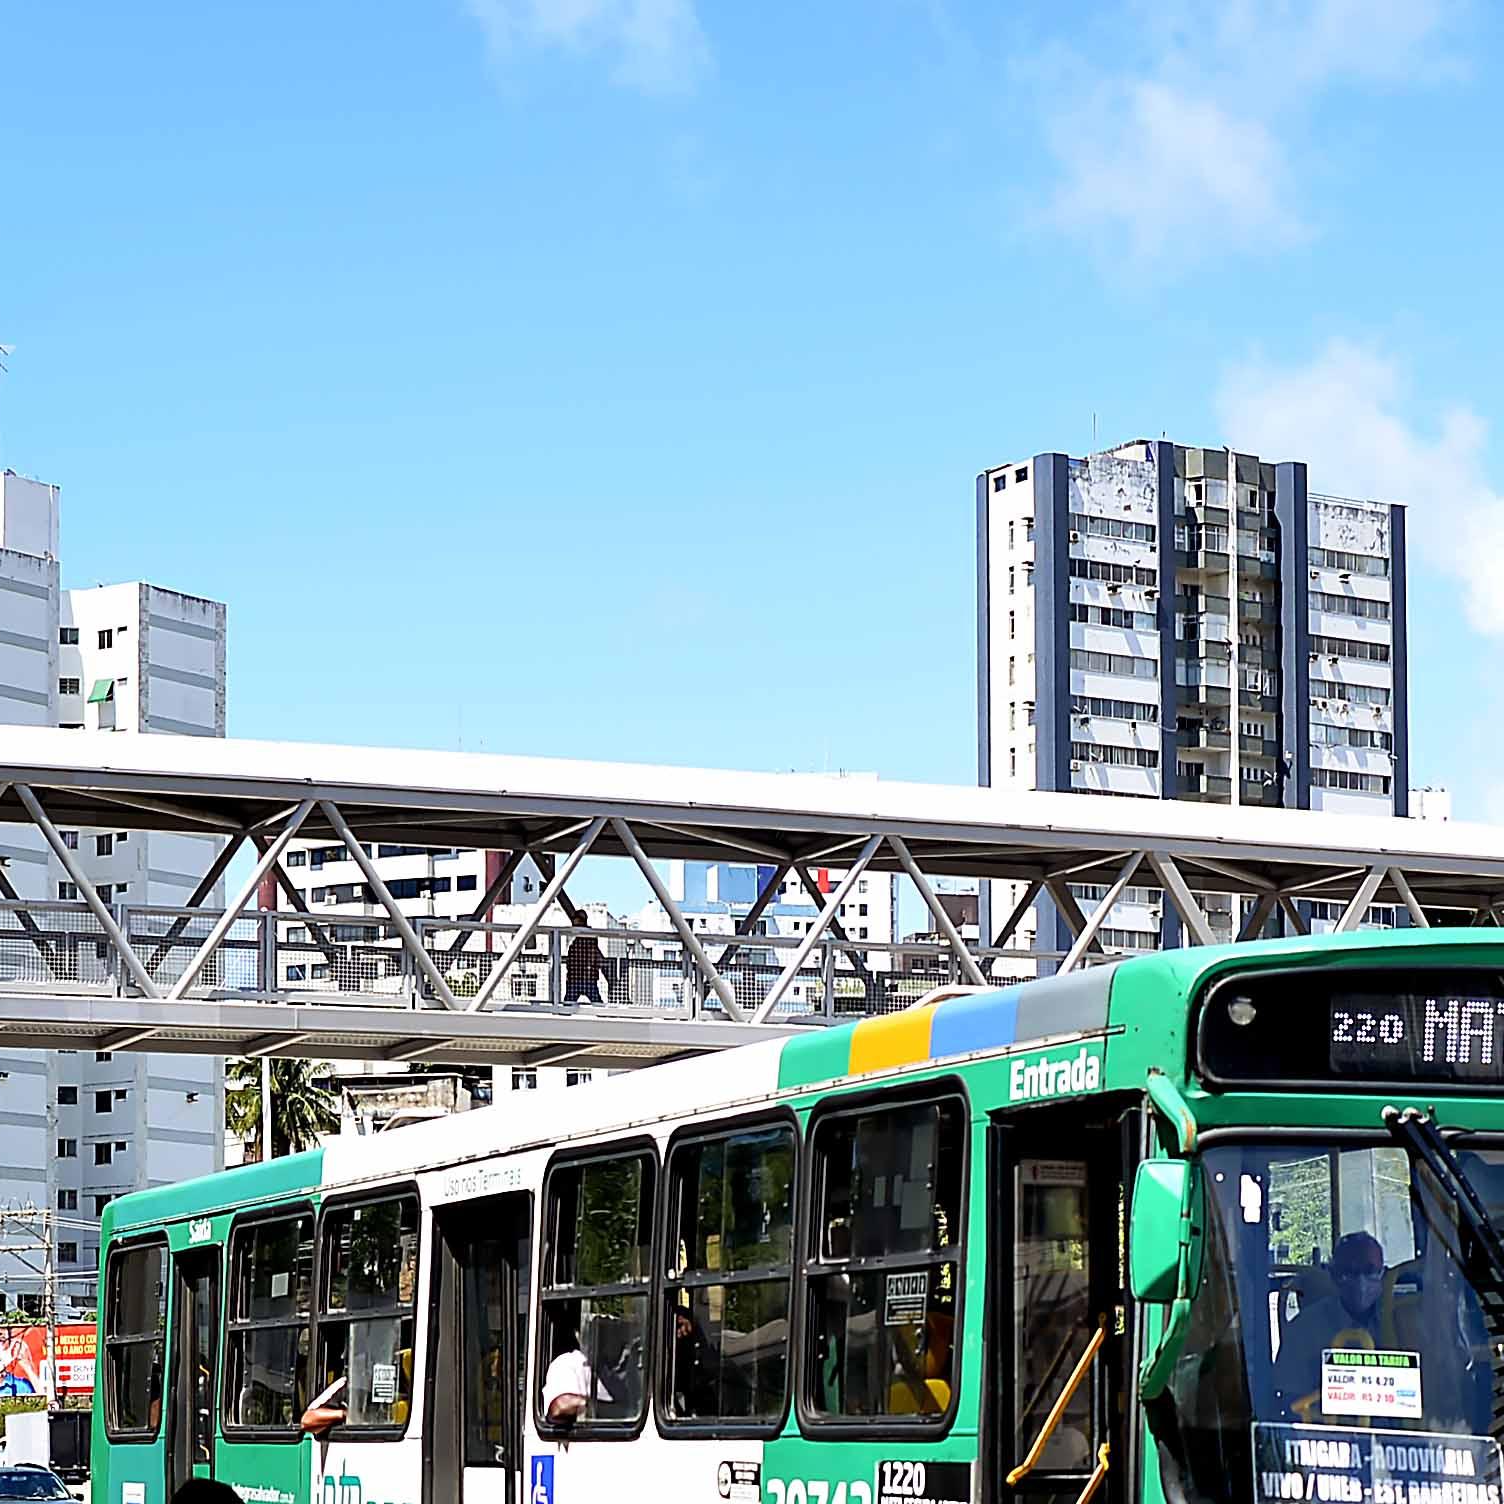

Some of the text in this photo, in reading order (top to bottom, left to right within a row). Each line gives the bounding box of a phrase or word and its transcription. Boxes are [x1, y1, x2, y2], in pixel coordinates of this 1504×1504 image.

[1332, 1011, 1404, 1044] 220
[1009, 1047, 1100, 1101] Entrada
[1372, 1443, 1476, 1477] RODOVIÁRIA
[881, 1461, 927, 1497] 1220
[1261, 1471, 1304, 1500] VIVO
